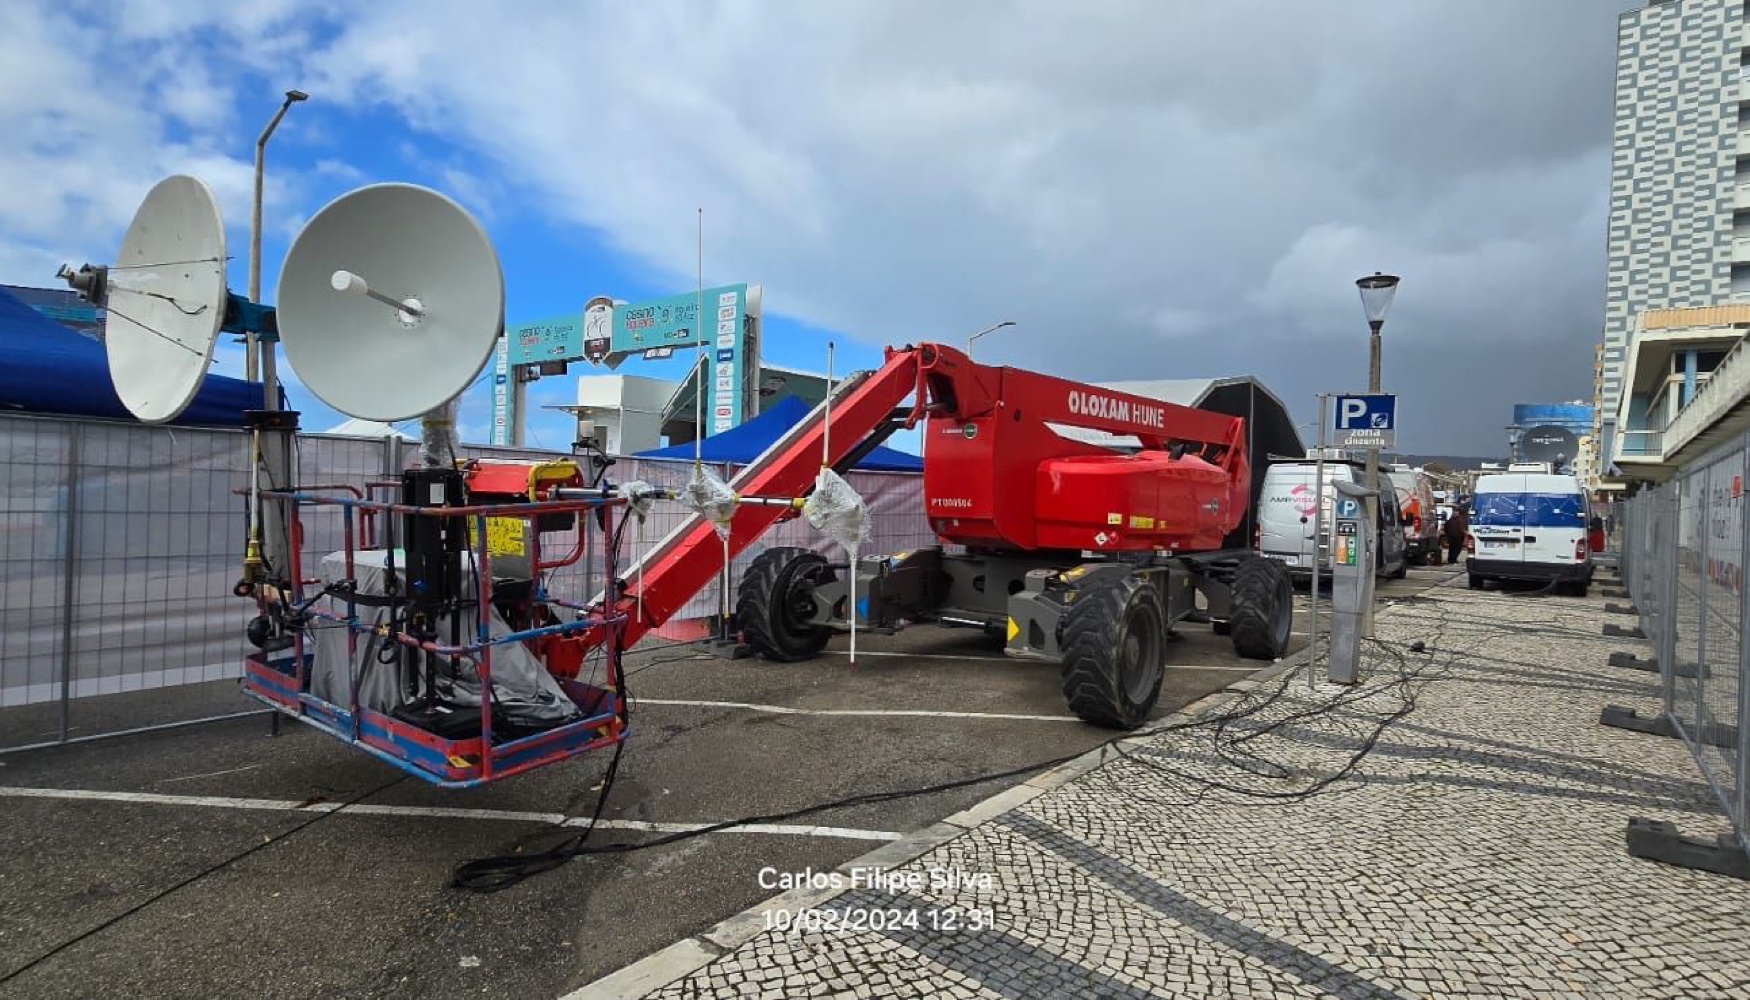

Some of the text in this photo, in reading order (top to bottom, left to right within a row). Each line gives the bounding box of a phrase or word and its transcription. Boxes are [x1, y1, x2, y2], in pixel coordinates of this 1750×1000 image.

[1132, 403, 1165, 428] HUNE
[1341, 398, 1367, 428] P
[1350, 429, 1381, 437] zona
[1343, 500, 1356, 516] P
